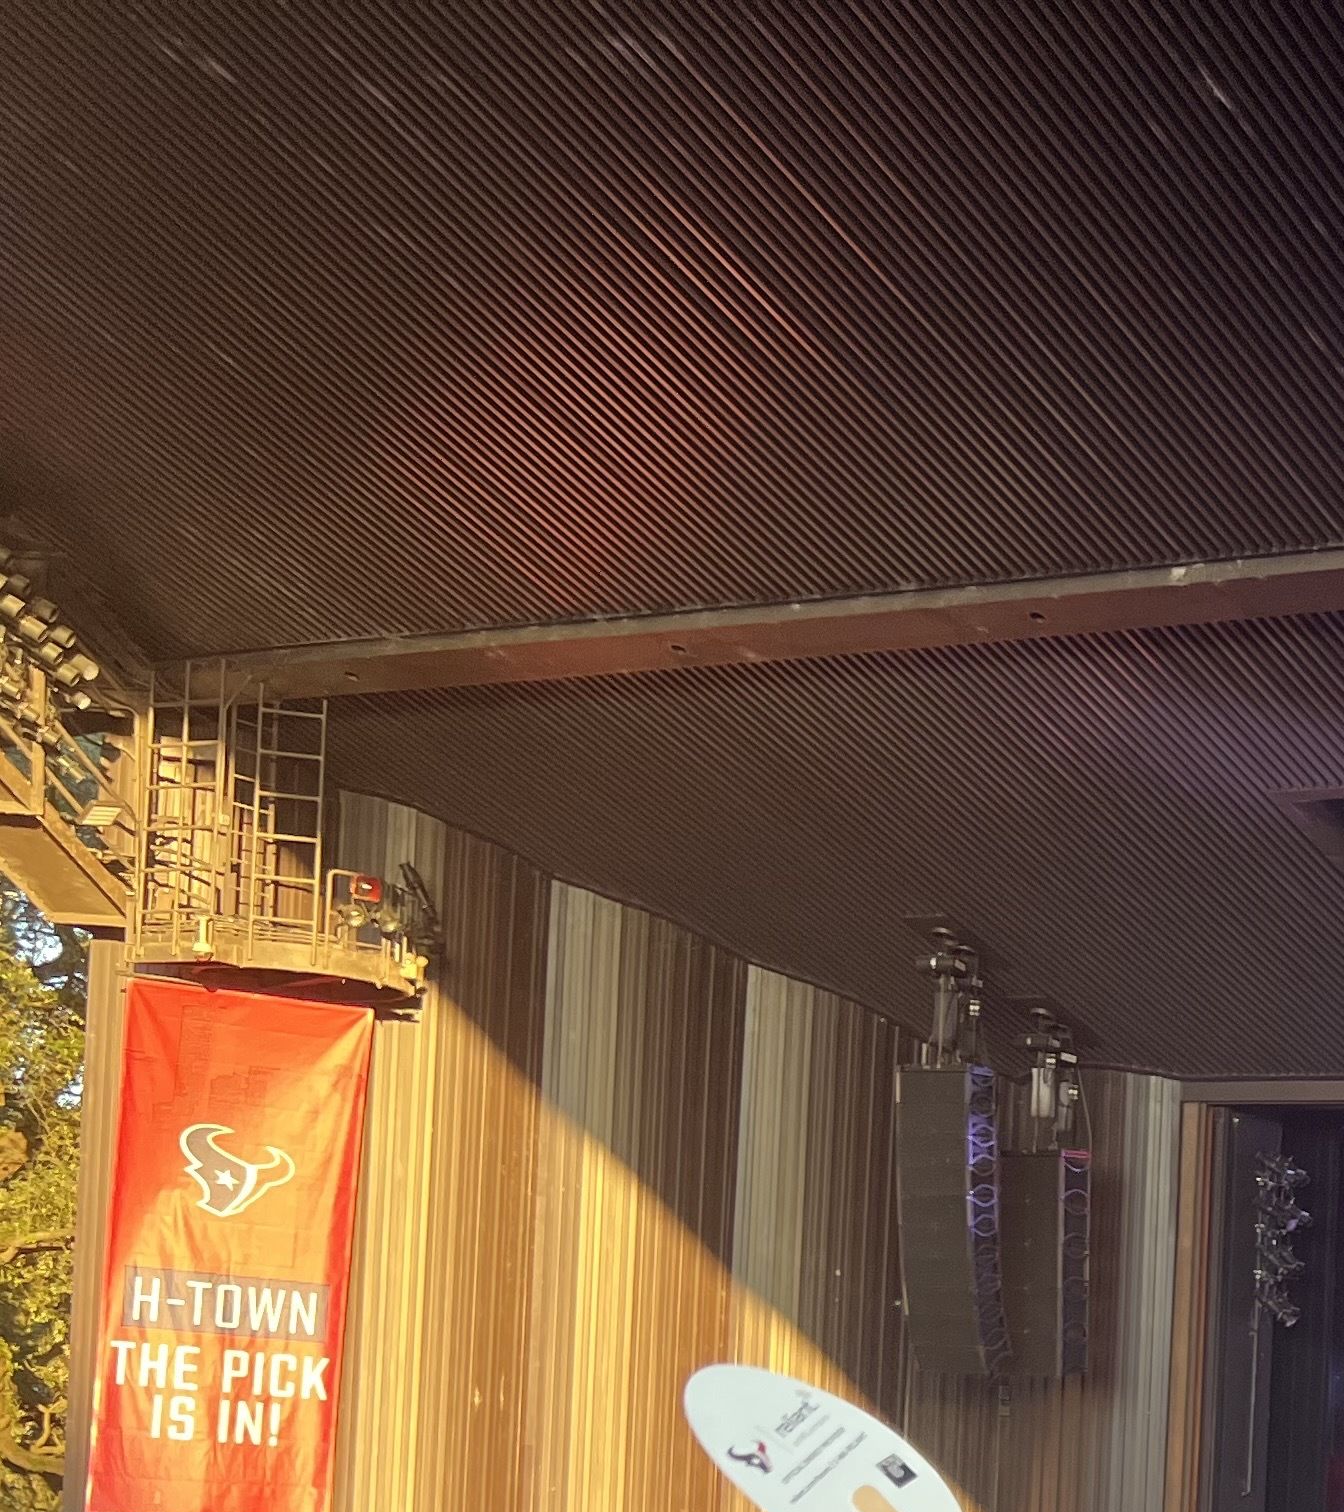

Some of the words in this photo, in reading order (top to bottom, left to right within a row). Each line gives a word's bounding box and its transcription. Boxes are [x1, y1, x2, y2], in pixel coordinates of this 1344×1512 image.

[131, 1274, 319, 1337] H-TOWN
[110, 1339, 201, 1392] THE
[222, 1349, 330, 1401] PICK
[150, 1394, 195, 1443] IS
[217, 1399, 282, 1448] IN!
